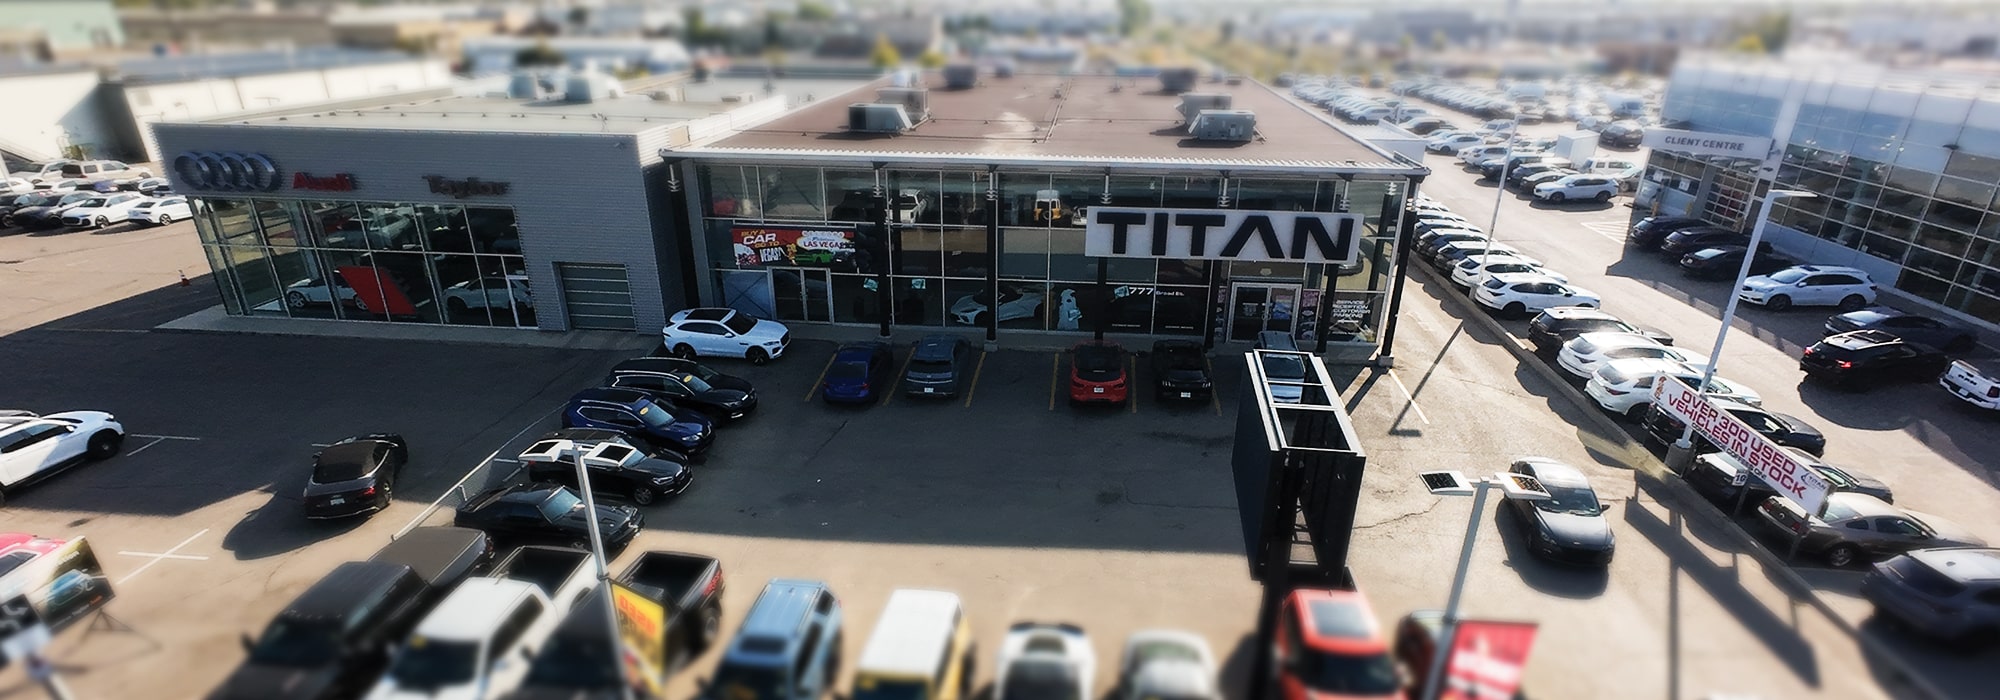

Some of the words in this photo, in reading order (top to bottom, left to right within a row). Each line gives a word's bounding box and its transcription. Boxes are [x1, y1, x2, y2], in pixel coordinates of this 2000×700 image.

[1665, 135, 1700, 146] CLIENT
[1702, 139, 1745, 151] CENTRE
[293, 171, 353, 192] Audi
[422, 174, 511, 199] Taylor
[743, 233, 777, 246] CAR
[803, 240, 818, 248] LAS
[819, 241, 845, 249] VEGAS
[1097, 212, 1354, 261] TITAN
[1129, 287, 1154, 296] 777
[1681, 390, 1719, 422] OVER
[1718, 416, 1750, 443] 300
[1751, 438, 1797, 475] USED
[1668, 393, 1731, 446] VEHICLES
[1732, 439, 1748, 458] IN
[1748, 452, 1807, 500] STOCK
